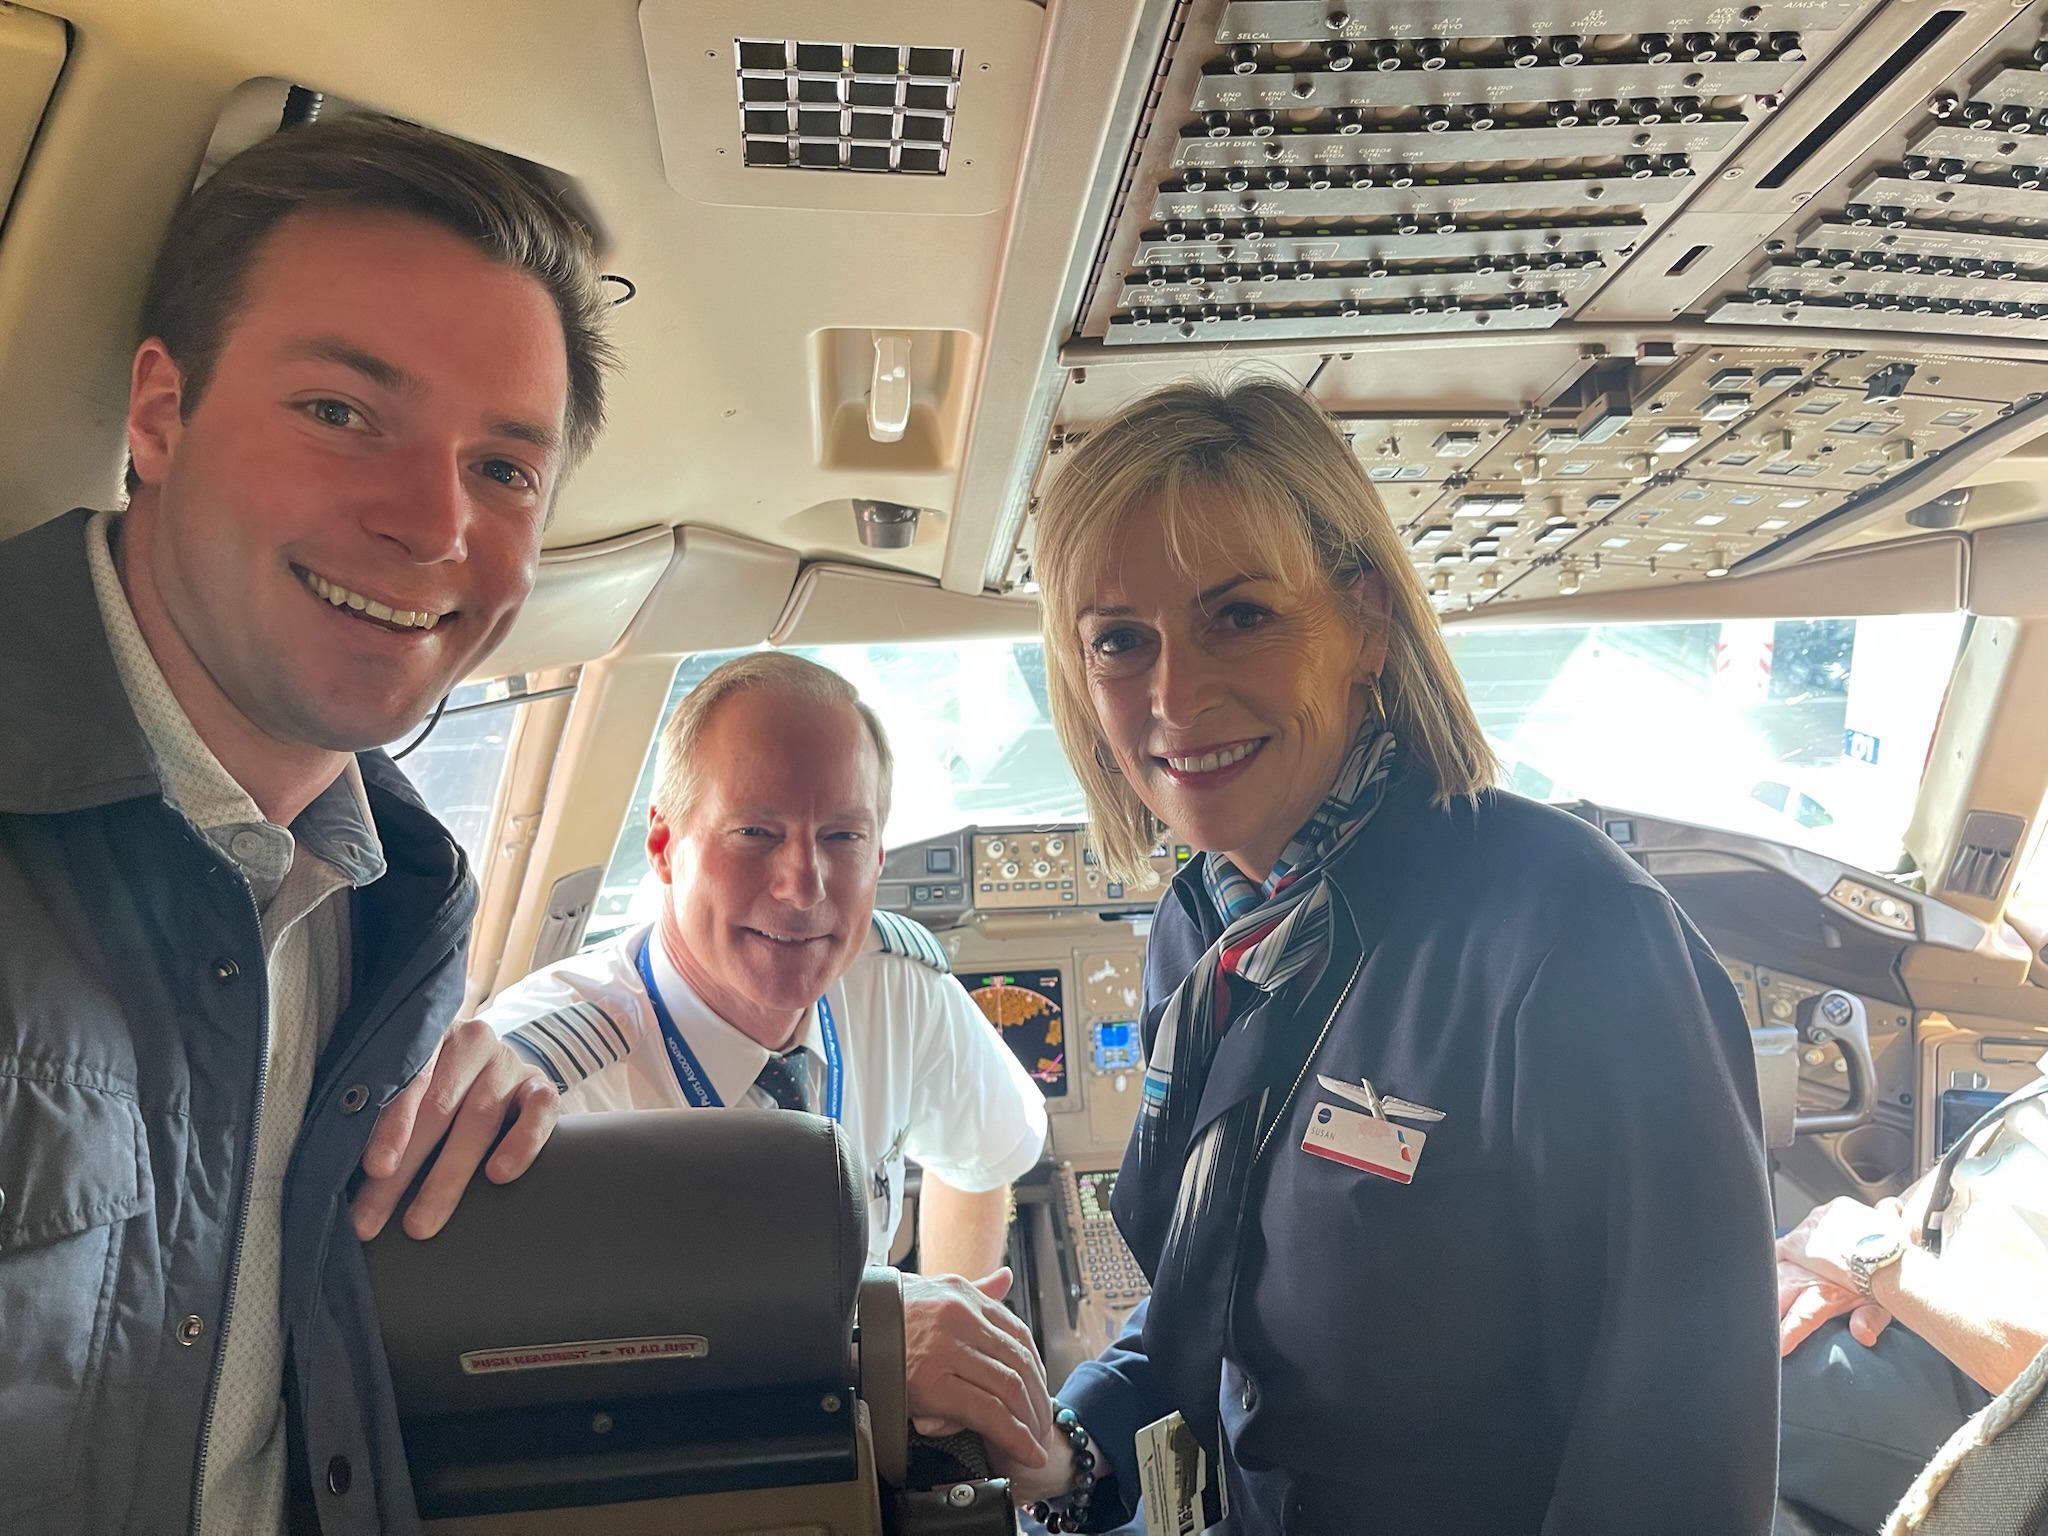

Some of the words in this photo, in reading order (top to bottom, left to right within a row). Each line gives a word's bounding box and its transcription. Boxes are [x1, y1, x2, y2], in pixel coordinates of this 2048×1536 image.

[1221, 31, 1230, 39] F
[1310, 1126, 1336, 1140] SUSAN
[471, 1358, 511, 1369] PUSH
[514, 1350, 590, 1366] HEADREST
[616, 1346, 636, 1356] TO
[639, 1342, 698, 1355] ADJUST
